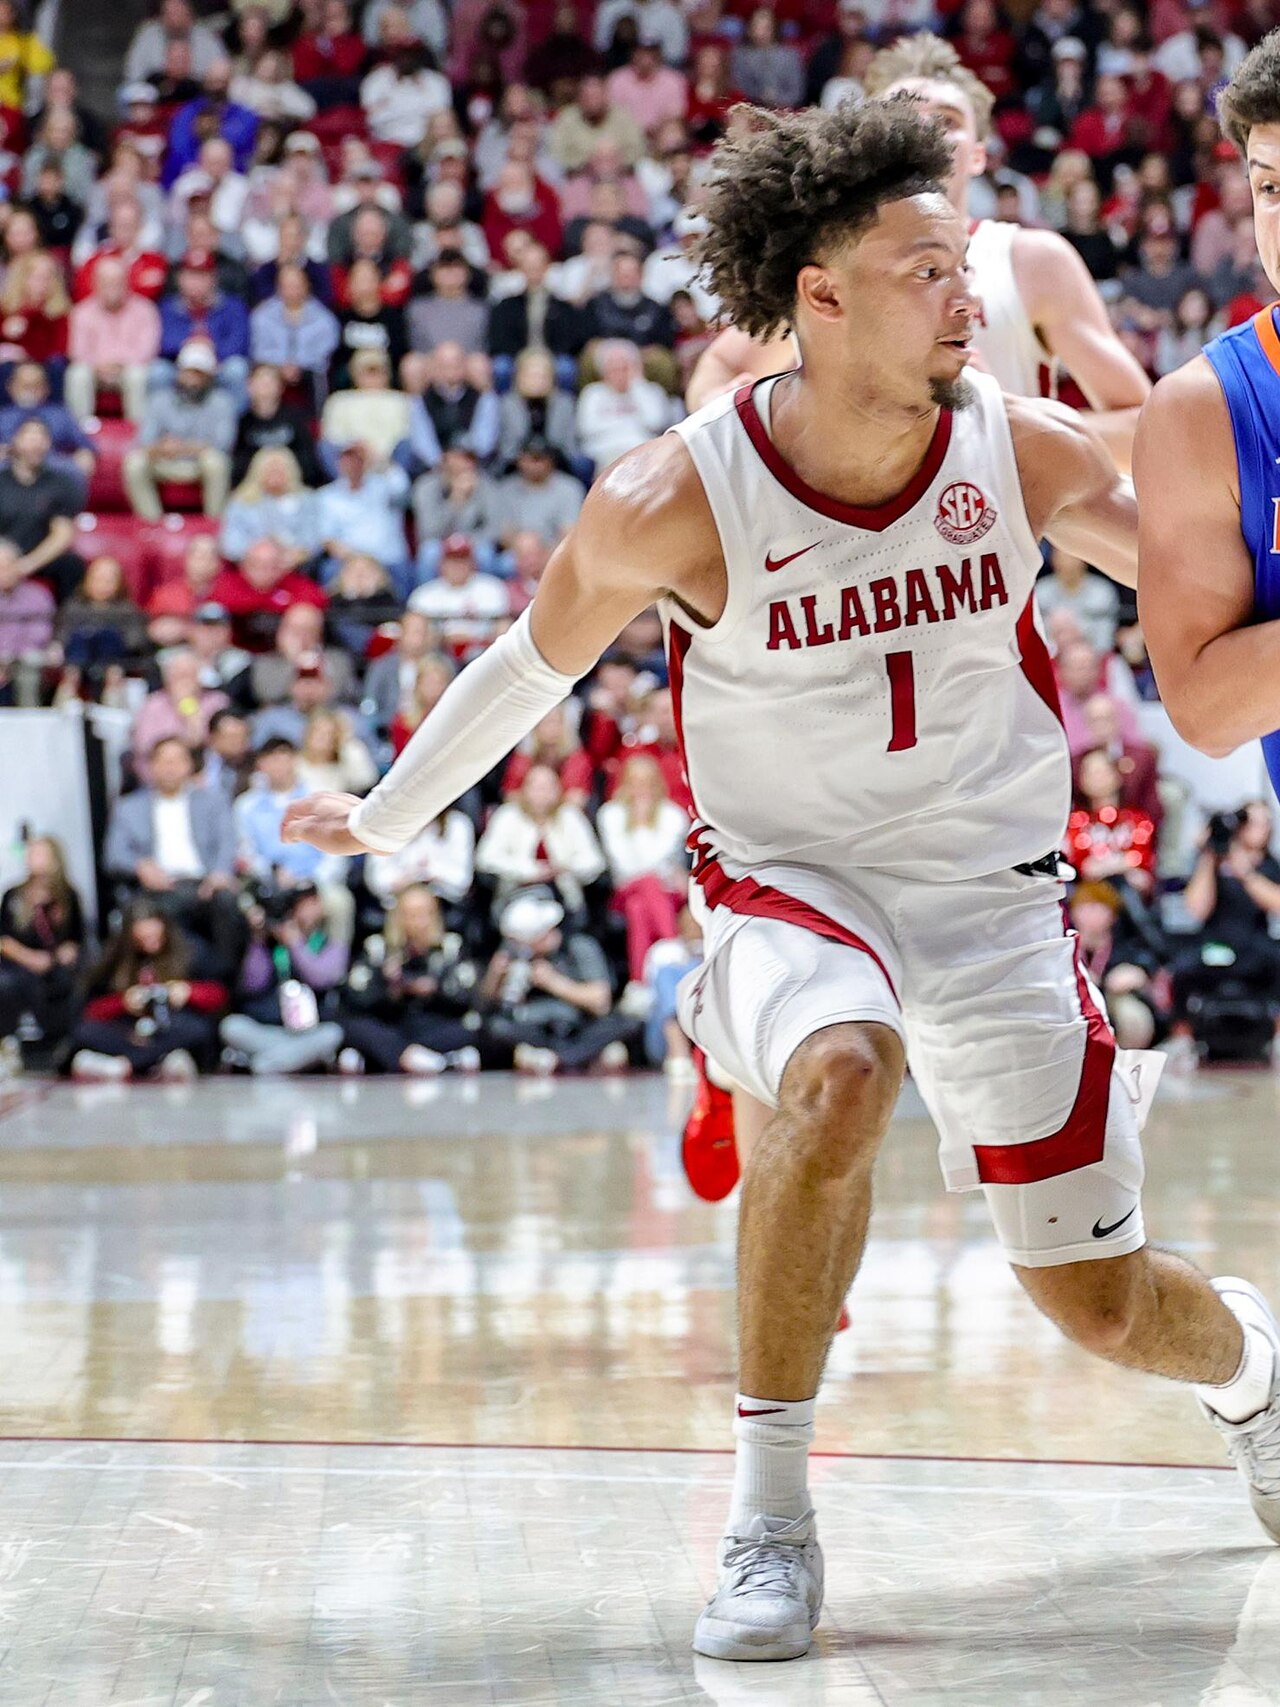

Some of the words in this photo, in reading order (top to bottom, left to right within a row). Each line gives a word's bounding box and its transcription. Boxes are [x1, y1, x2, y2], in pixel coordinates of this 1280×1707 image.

[940, 484, 984, 529] SEC
[766, 552, 1009, 650] ALABAMA
[885, 650, 918, 752] 1
